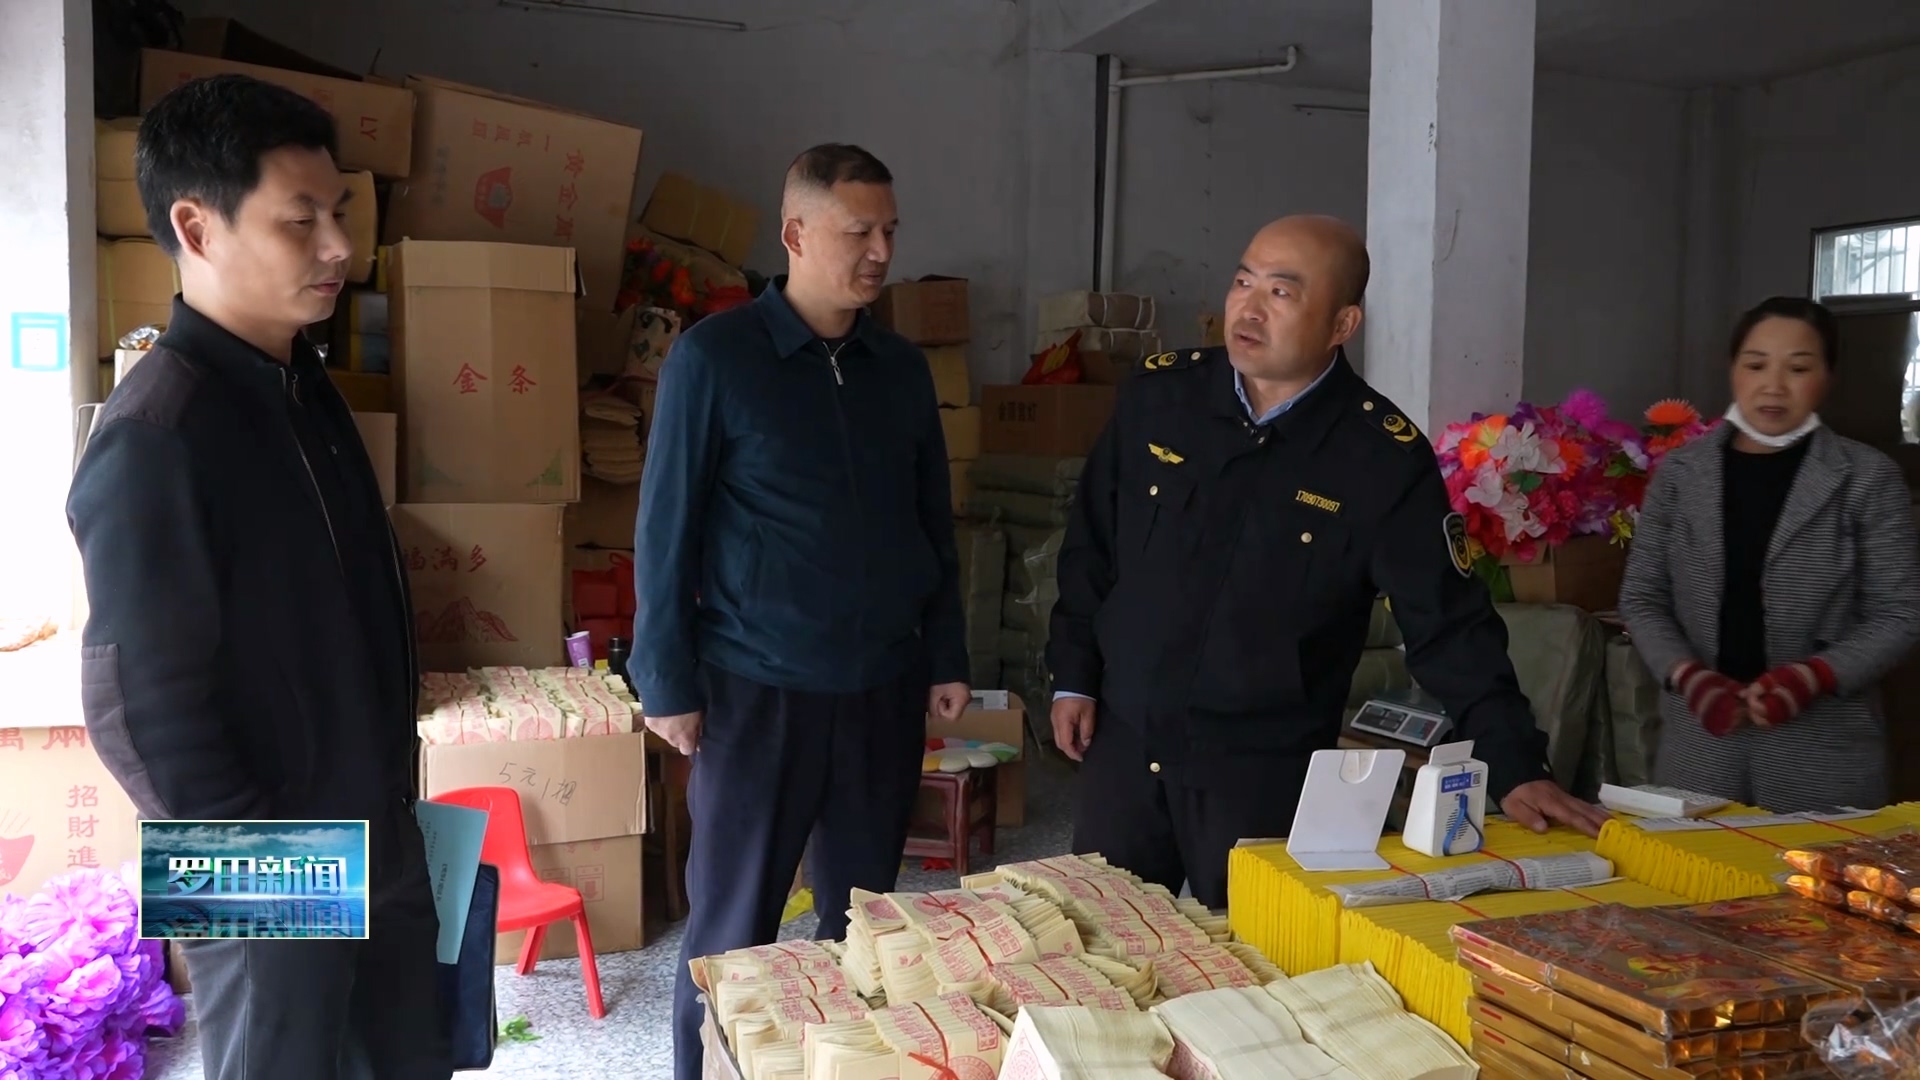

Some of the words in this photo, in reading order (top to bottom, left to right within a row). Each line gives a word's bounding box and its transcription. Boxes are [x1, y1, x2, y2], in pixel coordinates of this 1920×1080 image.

[360, 115, 379, 142] LY
[452, 362, 536, 394] 金条
[66, 784, 101, 869] 招財進
